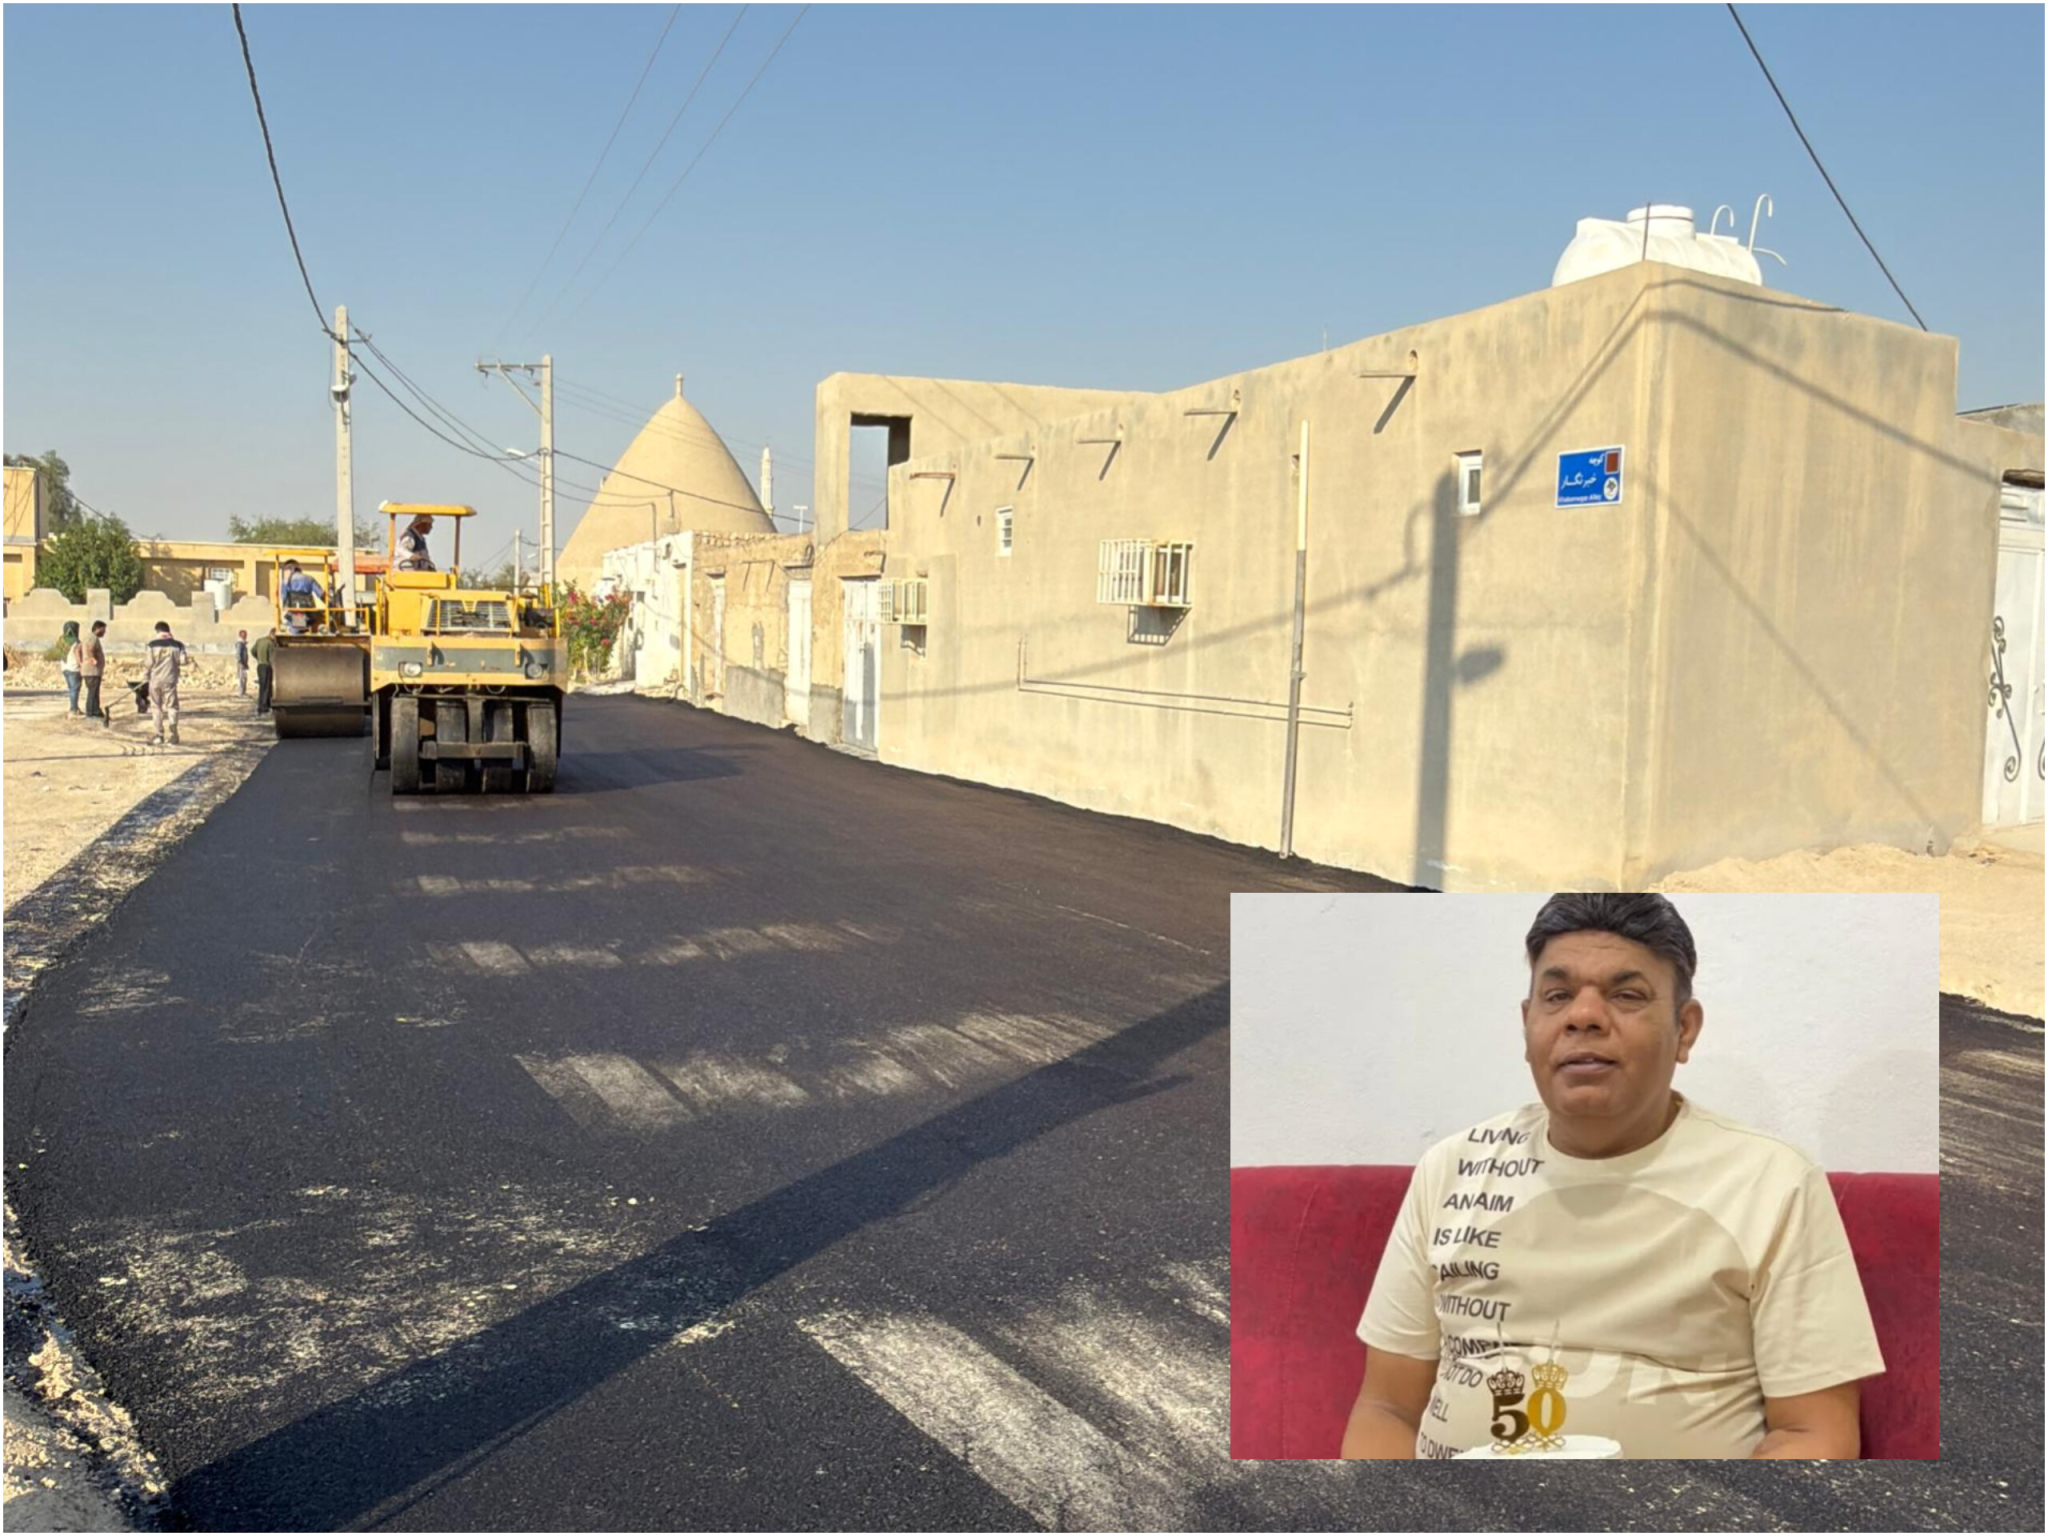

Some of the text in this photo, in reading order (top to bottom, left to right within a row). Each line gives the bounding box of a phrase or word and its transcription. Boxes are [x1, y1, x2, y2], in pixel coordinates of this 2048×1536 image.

[1589, 453, 1605, 466] کوچه
[1458, 1157, 1545, 1177] WITHOUT
[1433, 1226, 1502, 1249] IS LIKE
[1431, 1261, 1500, 1282] AILING
[1458, 1367, 1483, 1388] DO
[1490, 1387, 1566, 1443] 50
[1428, 1439, 1464, 1460] DWE
